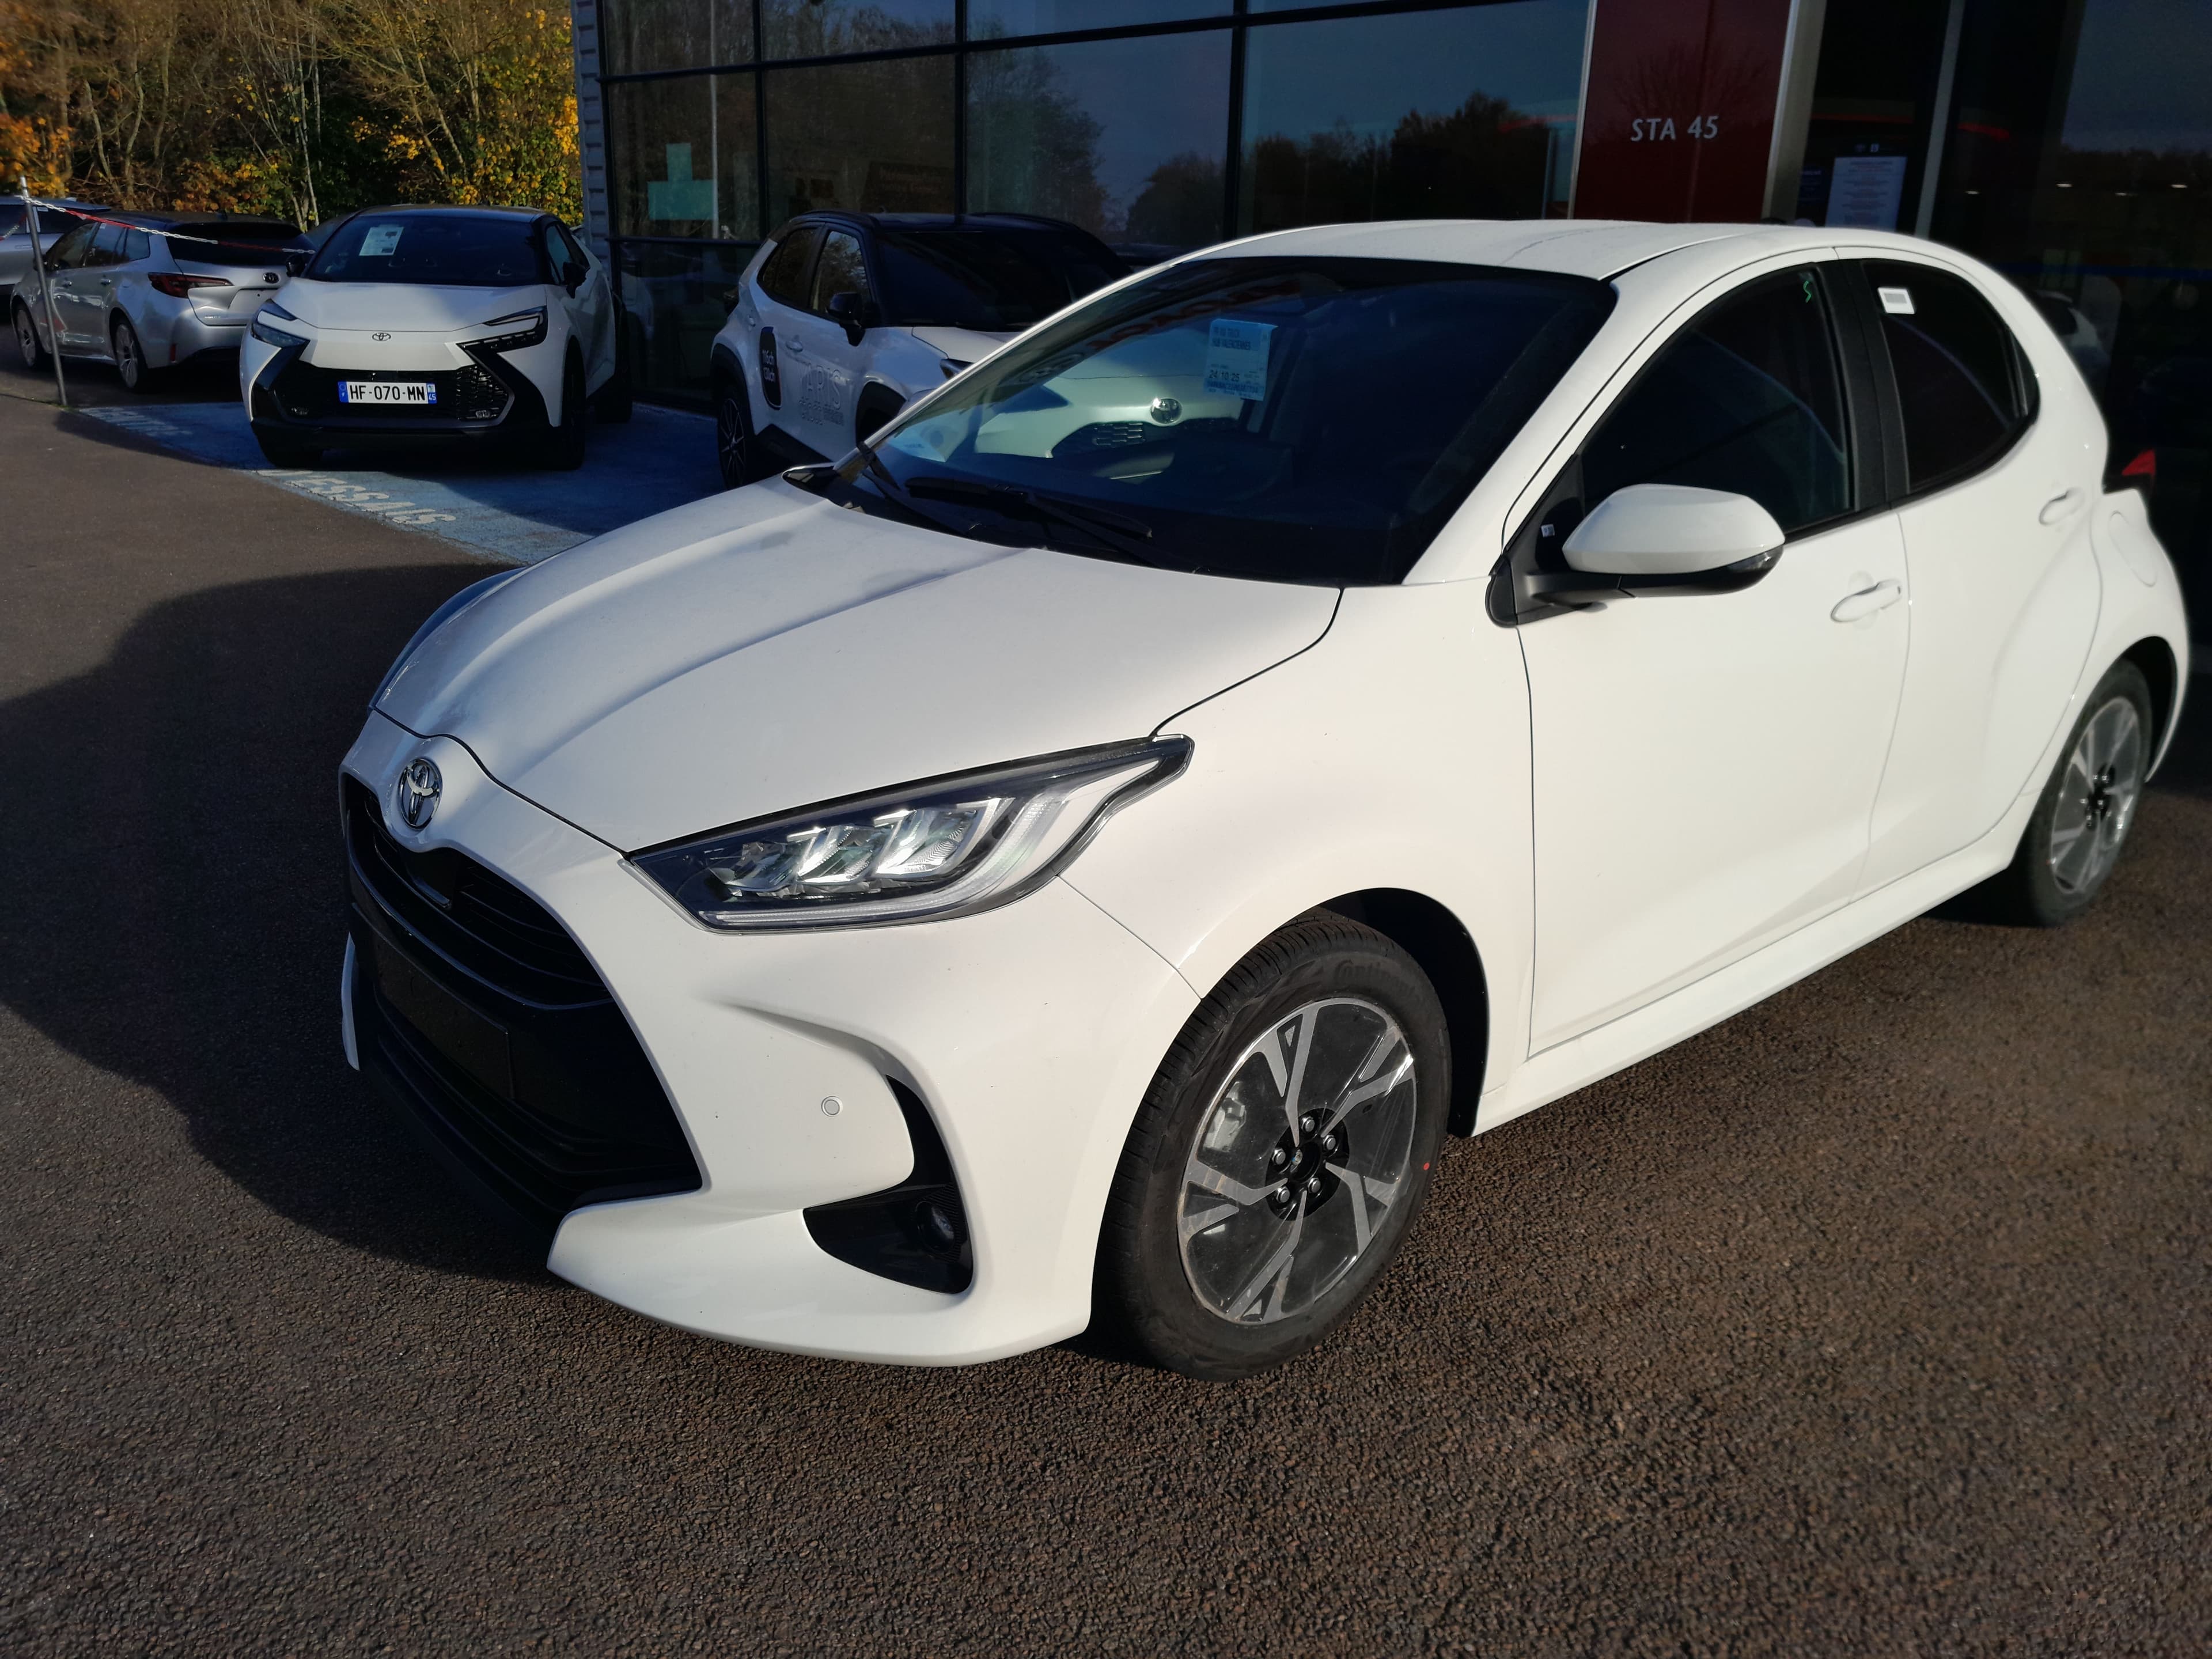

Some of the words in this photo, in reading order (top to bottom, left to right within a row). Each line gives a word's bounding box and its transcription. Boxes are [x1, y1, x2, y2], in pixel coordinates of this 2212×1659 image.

[1630, 118, 1676, 142] STA
[1687, 115, 1719, 139] 45
[350, 384, 425, 400] HF-070-MN
